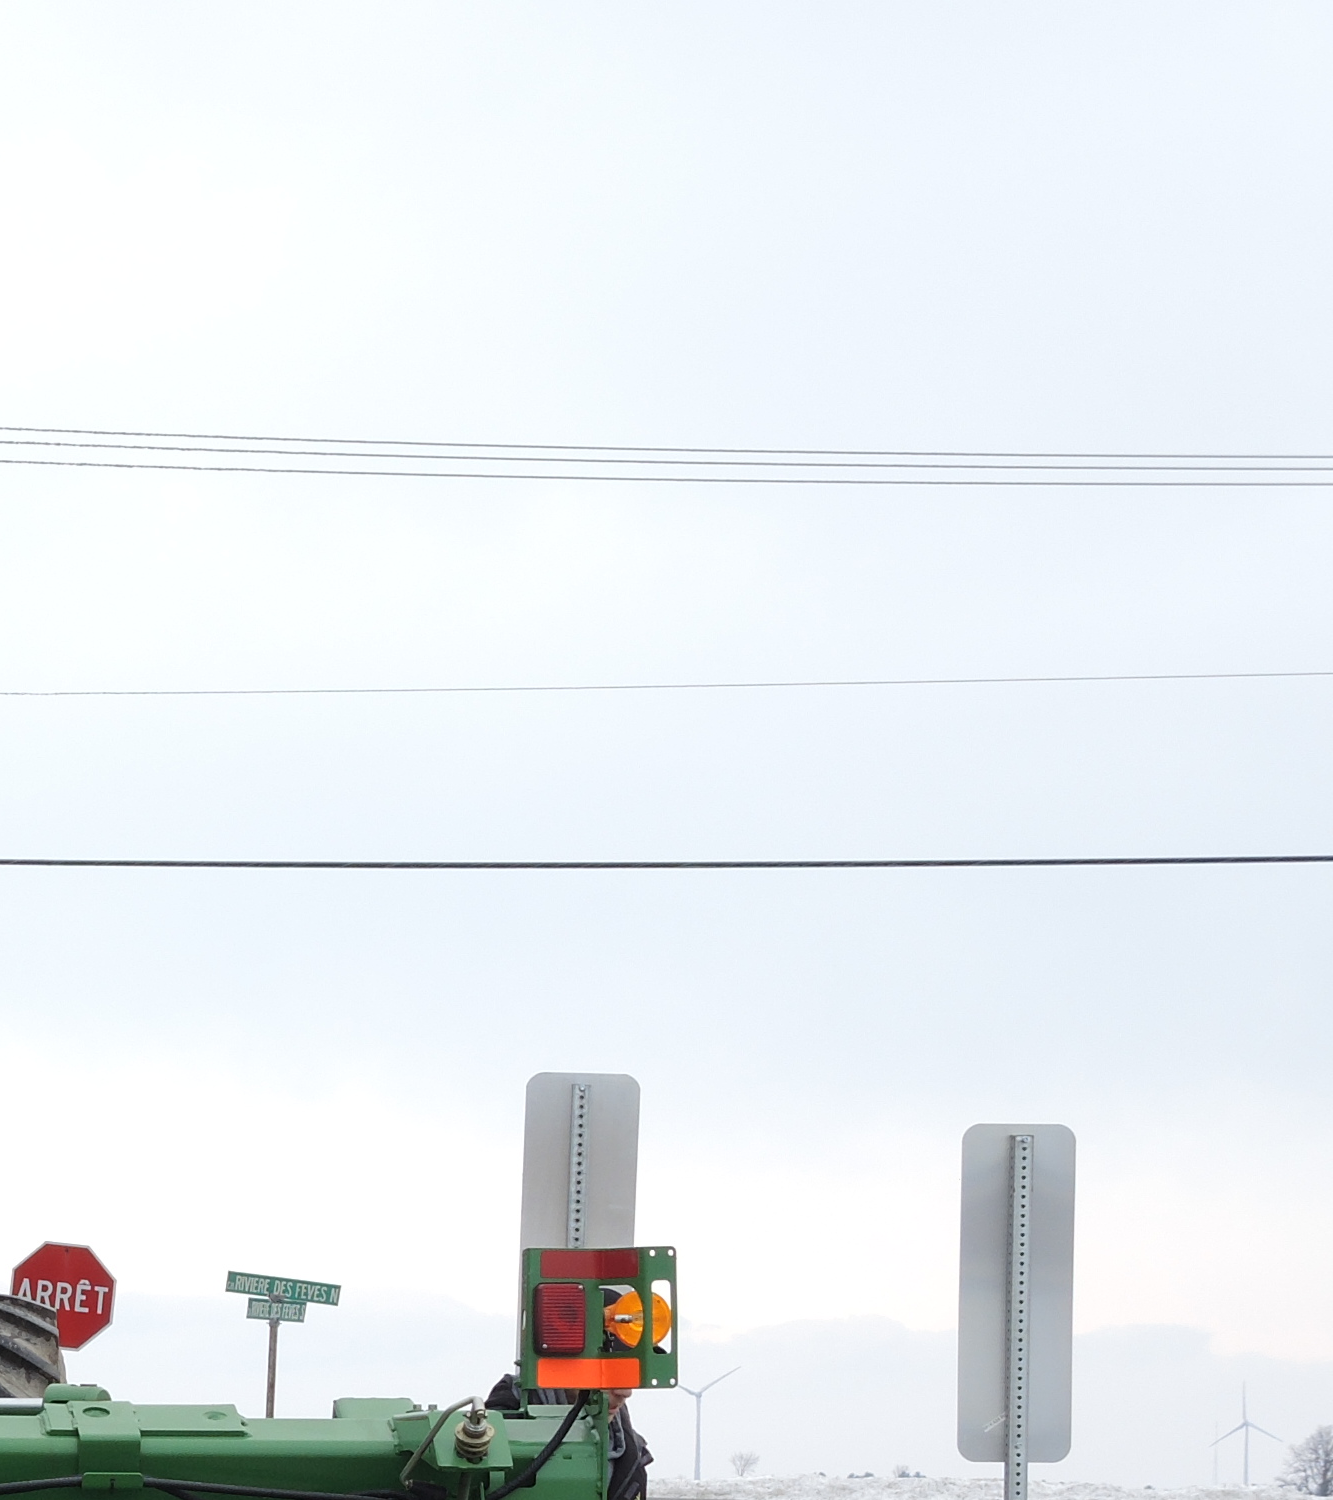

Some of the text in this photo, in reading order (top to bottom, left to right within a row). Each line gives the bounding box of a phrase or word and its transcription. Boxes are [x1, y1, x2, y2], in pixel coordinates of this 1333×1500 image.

[17, 1277, 110, 1315] ARRÊT
[235, 1275, 271, 1294] RIVIERE
[273, 1280, 293, 1298] DES
[295, 1283, 327, 1302] FEVES
[329, 1288, 339, 1303] N
